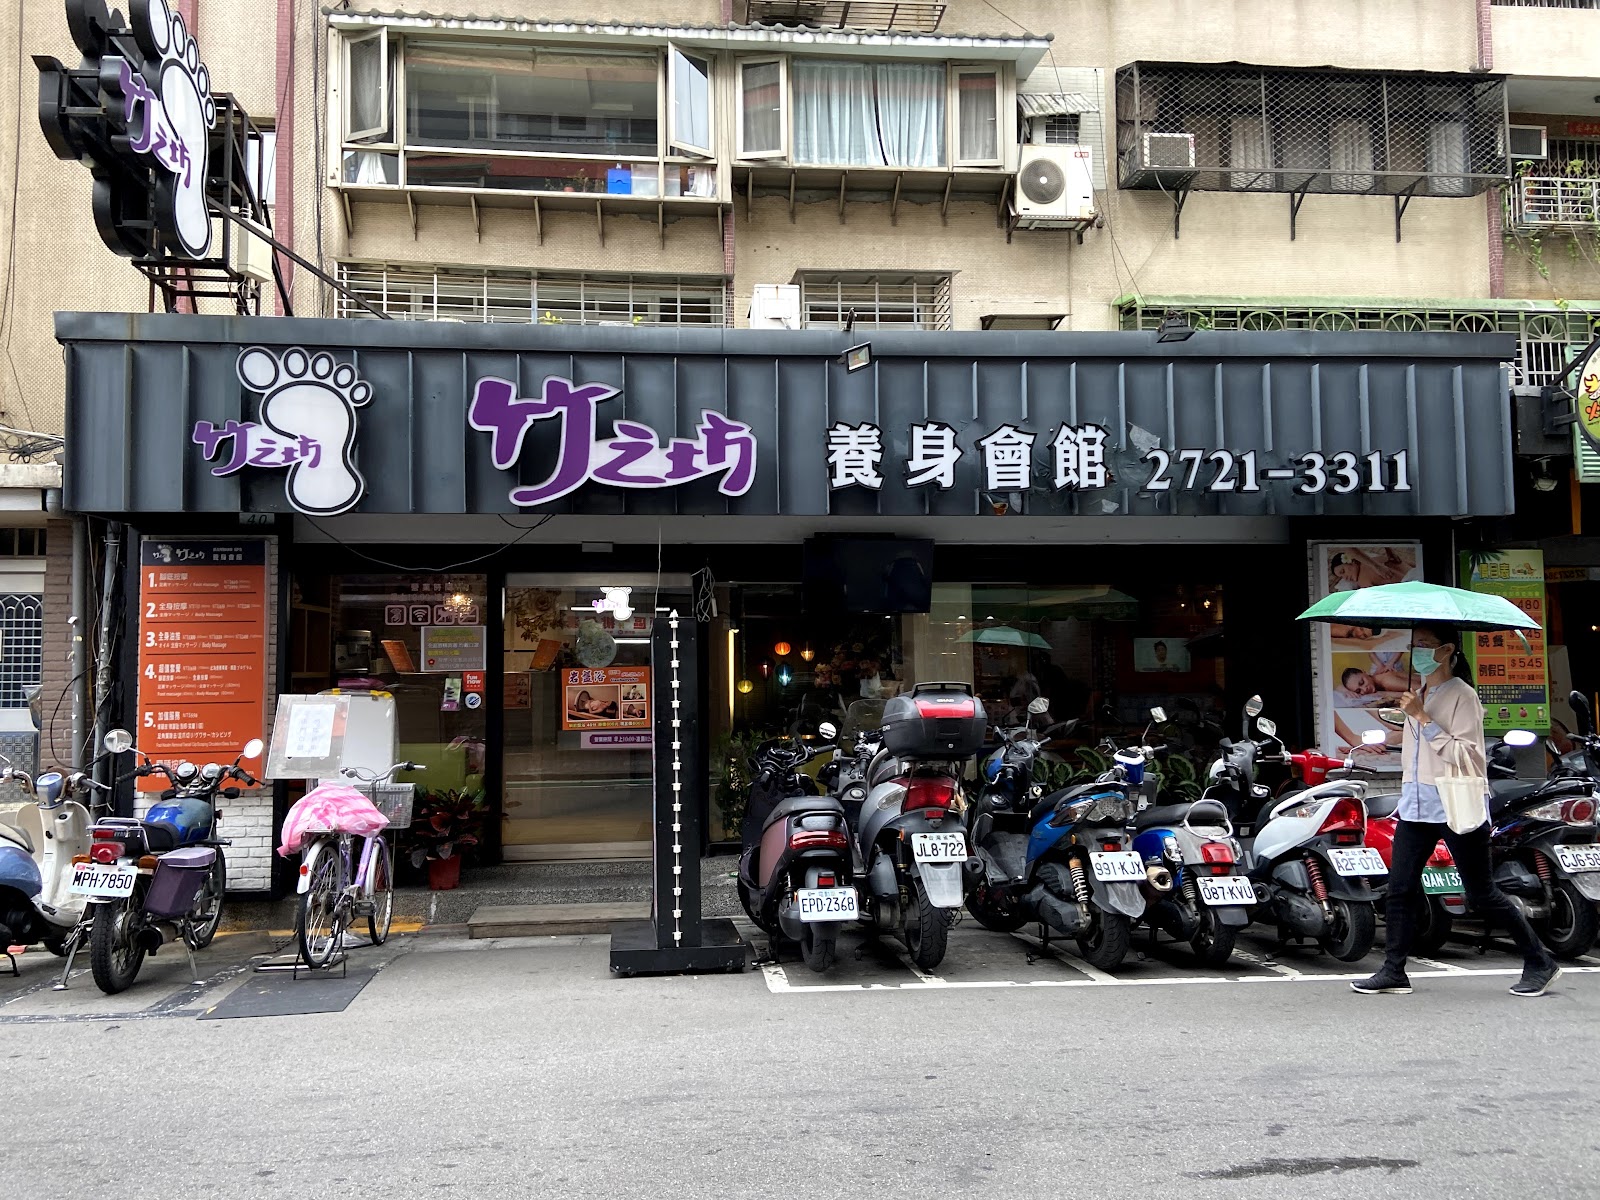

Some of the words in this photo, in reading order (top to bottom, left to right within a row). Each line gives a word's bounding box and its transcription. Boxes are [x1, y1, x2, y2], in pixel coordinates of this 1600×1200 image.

[192, 420, 321, 475] 竹之坊
[470, 377, 757, 503] 竹之坊
[827, 423, 1107, 491] 養身會館
[1145, 449, 1411, 492] 2721-3311
[1478, 635, 1504, 648] 晚餐
[1479, 664, 1505, 677] 例假日
[1511, 658, 1542, 668] $545
[916, 842, 965, 857] JL8-722
[1095, 860, 1144, 876] 991-KJX
[1560, 853, 1600, 868] CJ6-58
[72, 872, 133, 889] MPH-7850
[1203, 886, 1253, 900] 087-KVU
[801, 897, 855, 913] EPD-2368
